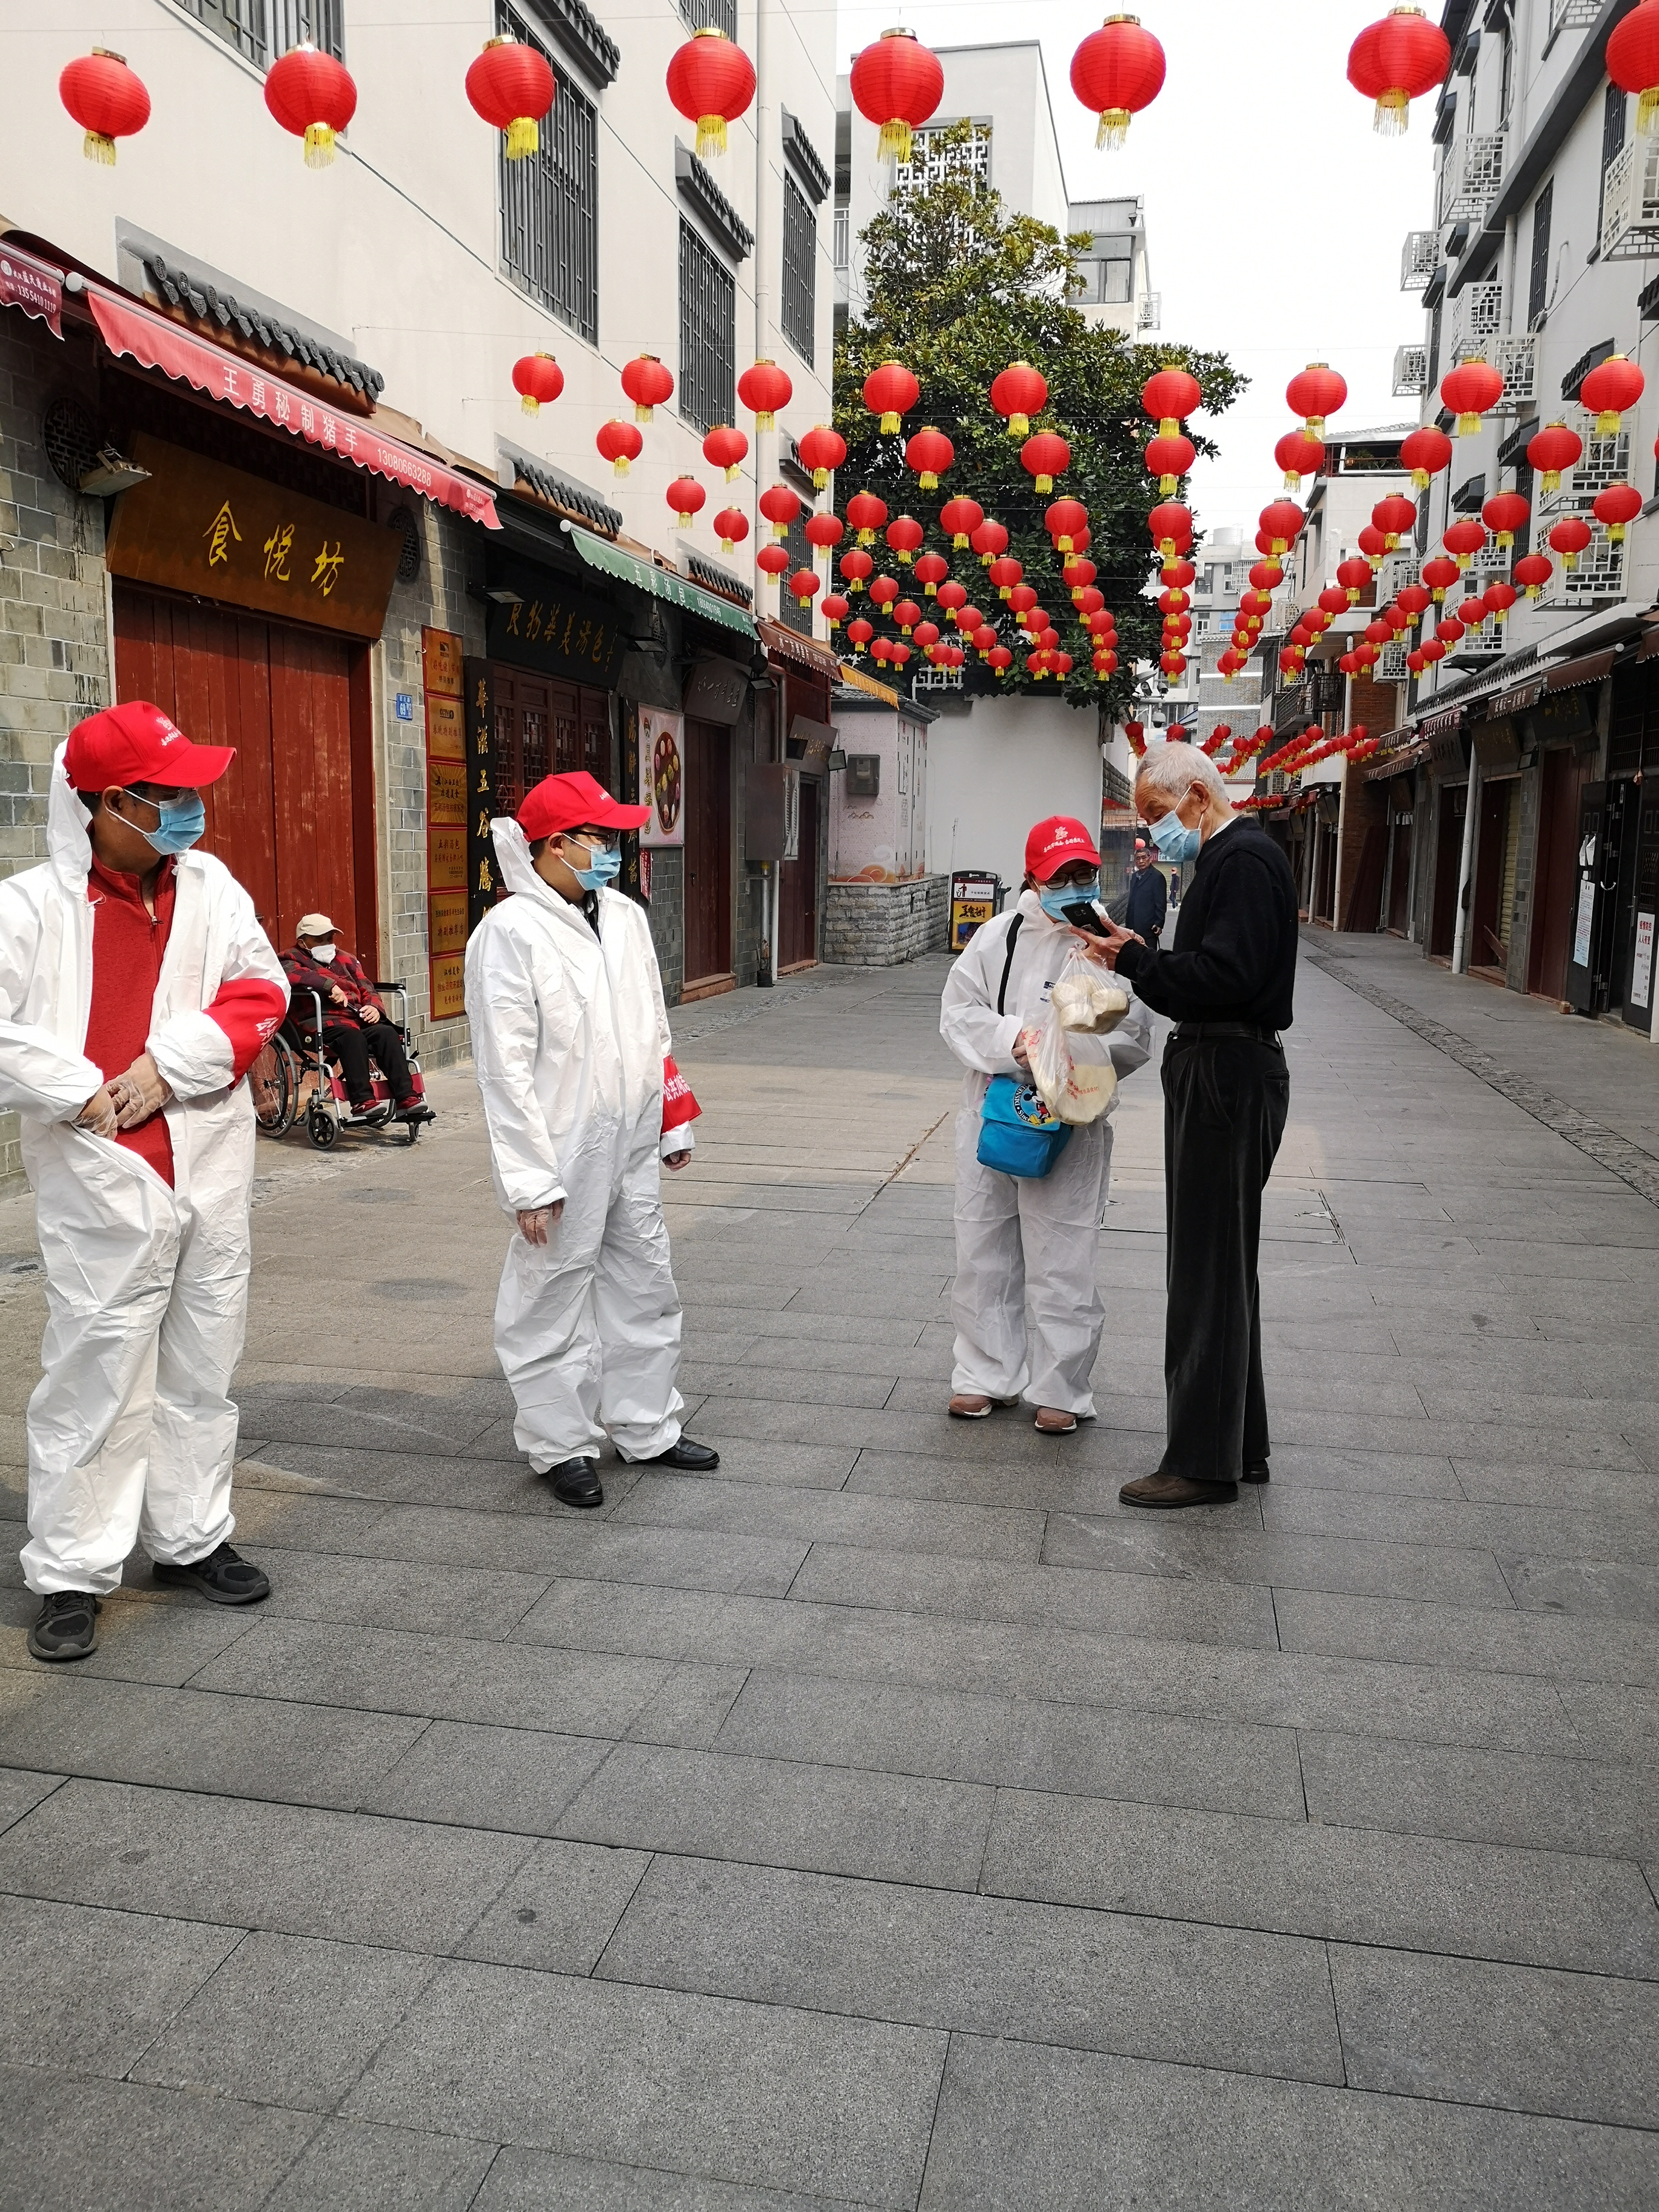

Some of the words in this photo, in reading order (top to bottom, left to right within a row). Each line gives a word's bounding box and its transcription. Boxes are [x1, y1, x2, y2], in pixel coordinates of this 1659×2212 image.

[223, 366, 358, 453] 王勇秘制猪手
[377, 447, 432, 488] 13080663288
[201, 499, 344, 597] 食悦坊
[634, 565, 686, 603] 五彩汤包
